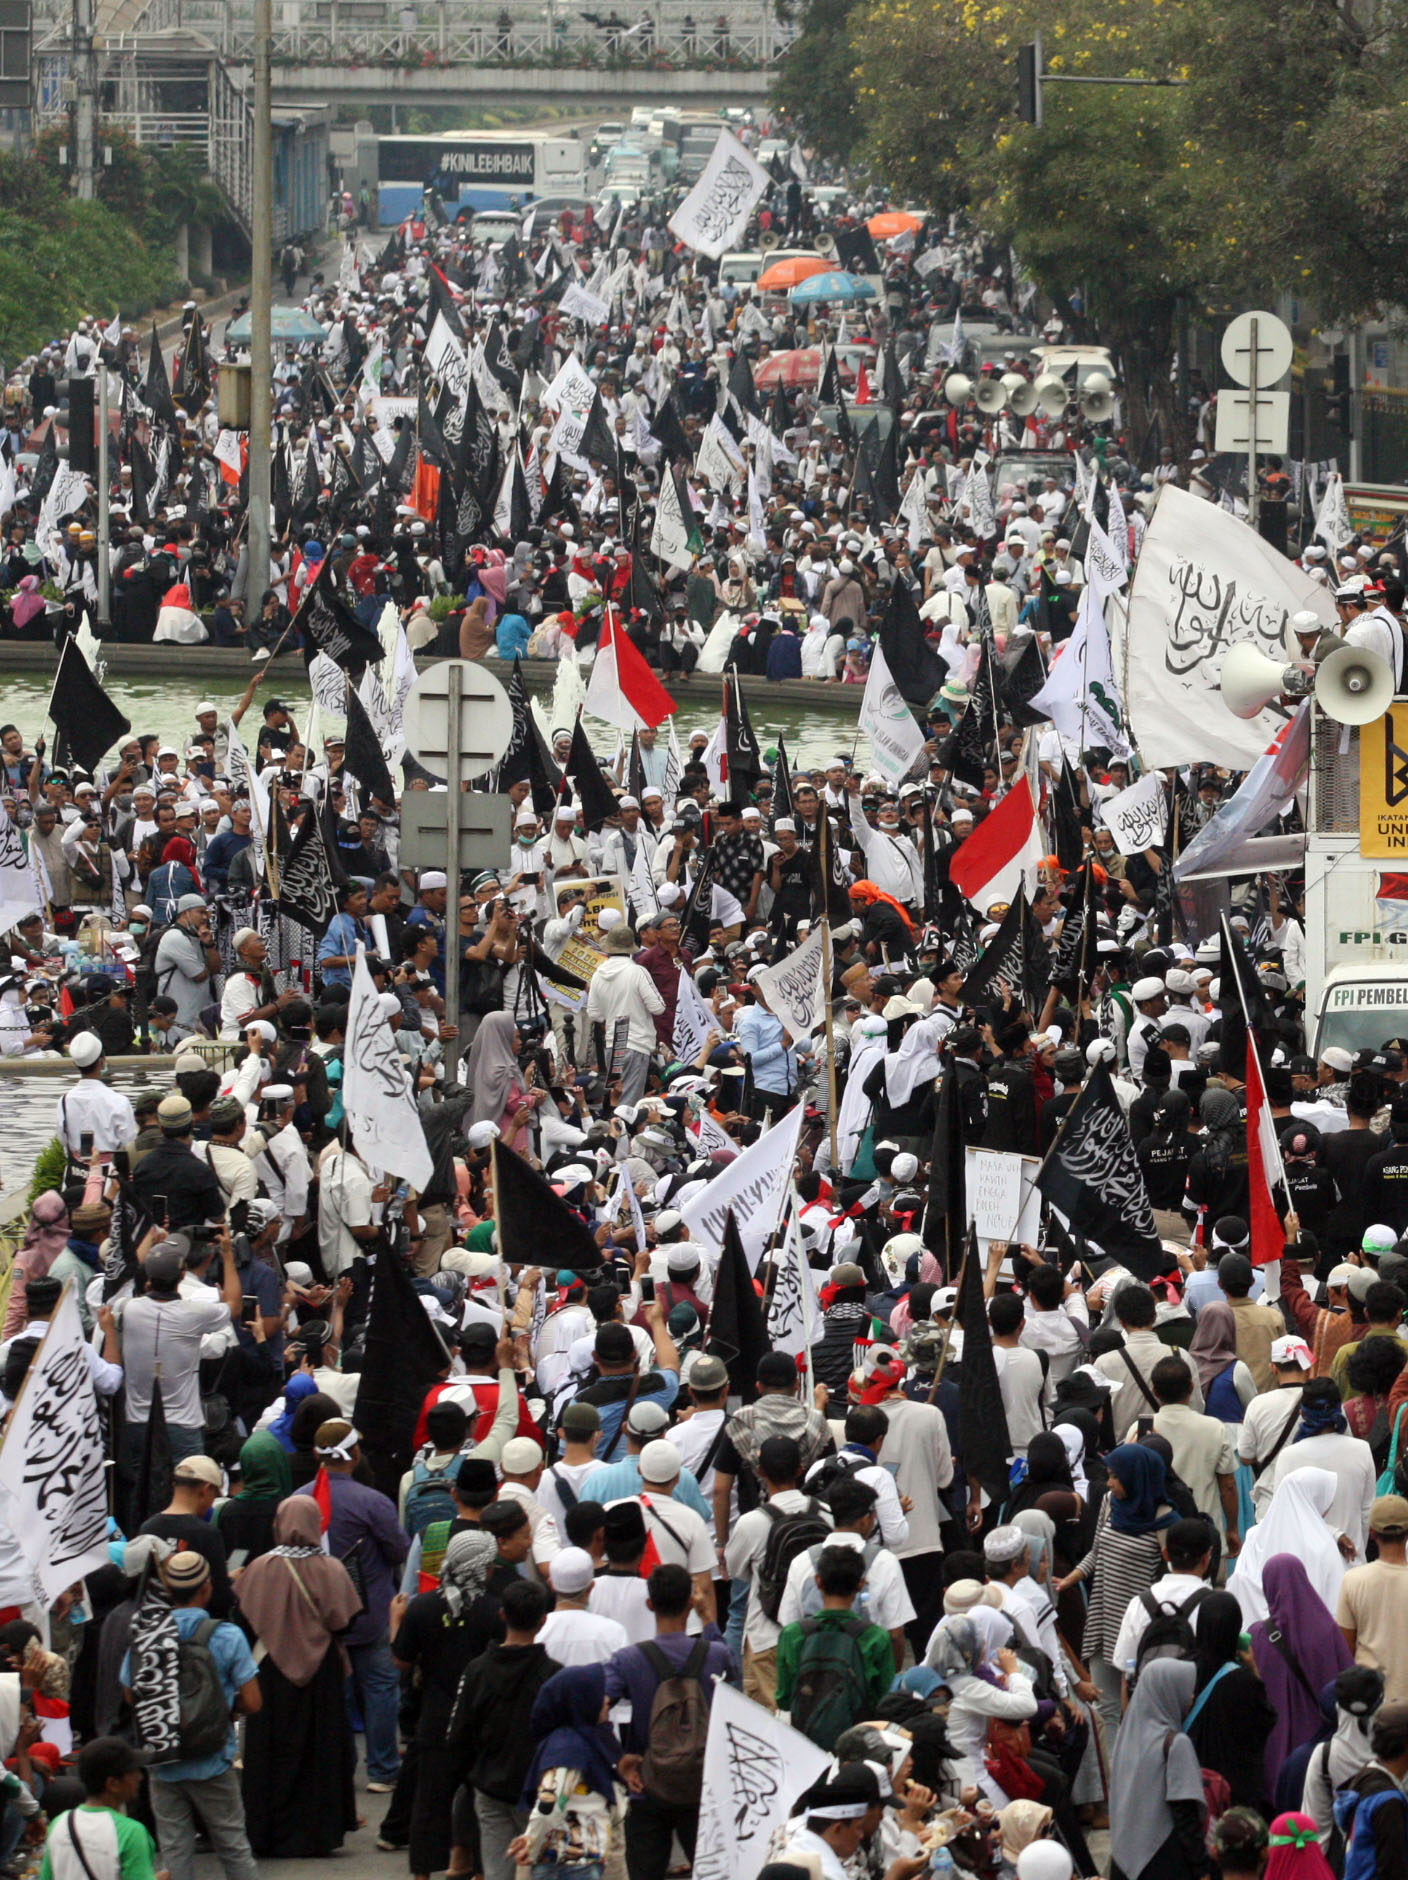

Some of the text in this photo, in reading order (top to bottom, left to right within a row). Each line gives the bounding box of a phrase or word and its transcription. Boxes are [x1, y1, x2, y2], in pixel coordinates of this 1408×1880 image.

[441, 153, 533, 175] #KINILEBIHBAIK
[1339, 932, 1381, 944] FPI
[1334, 990, 1355, 1006] FPI
